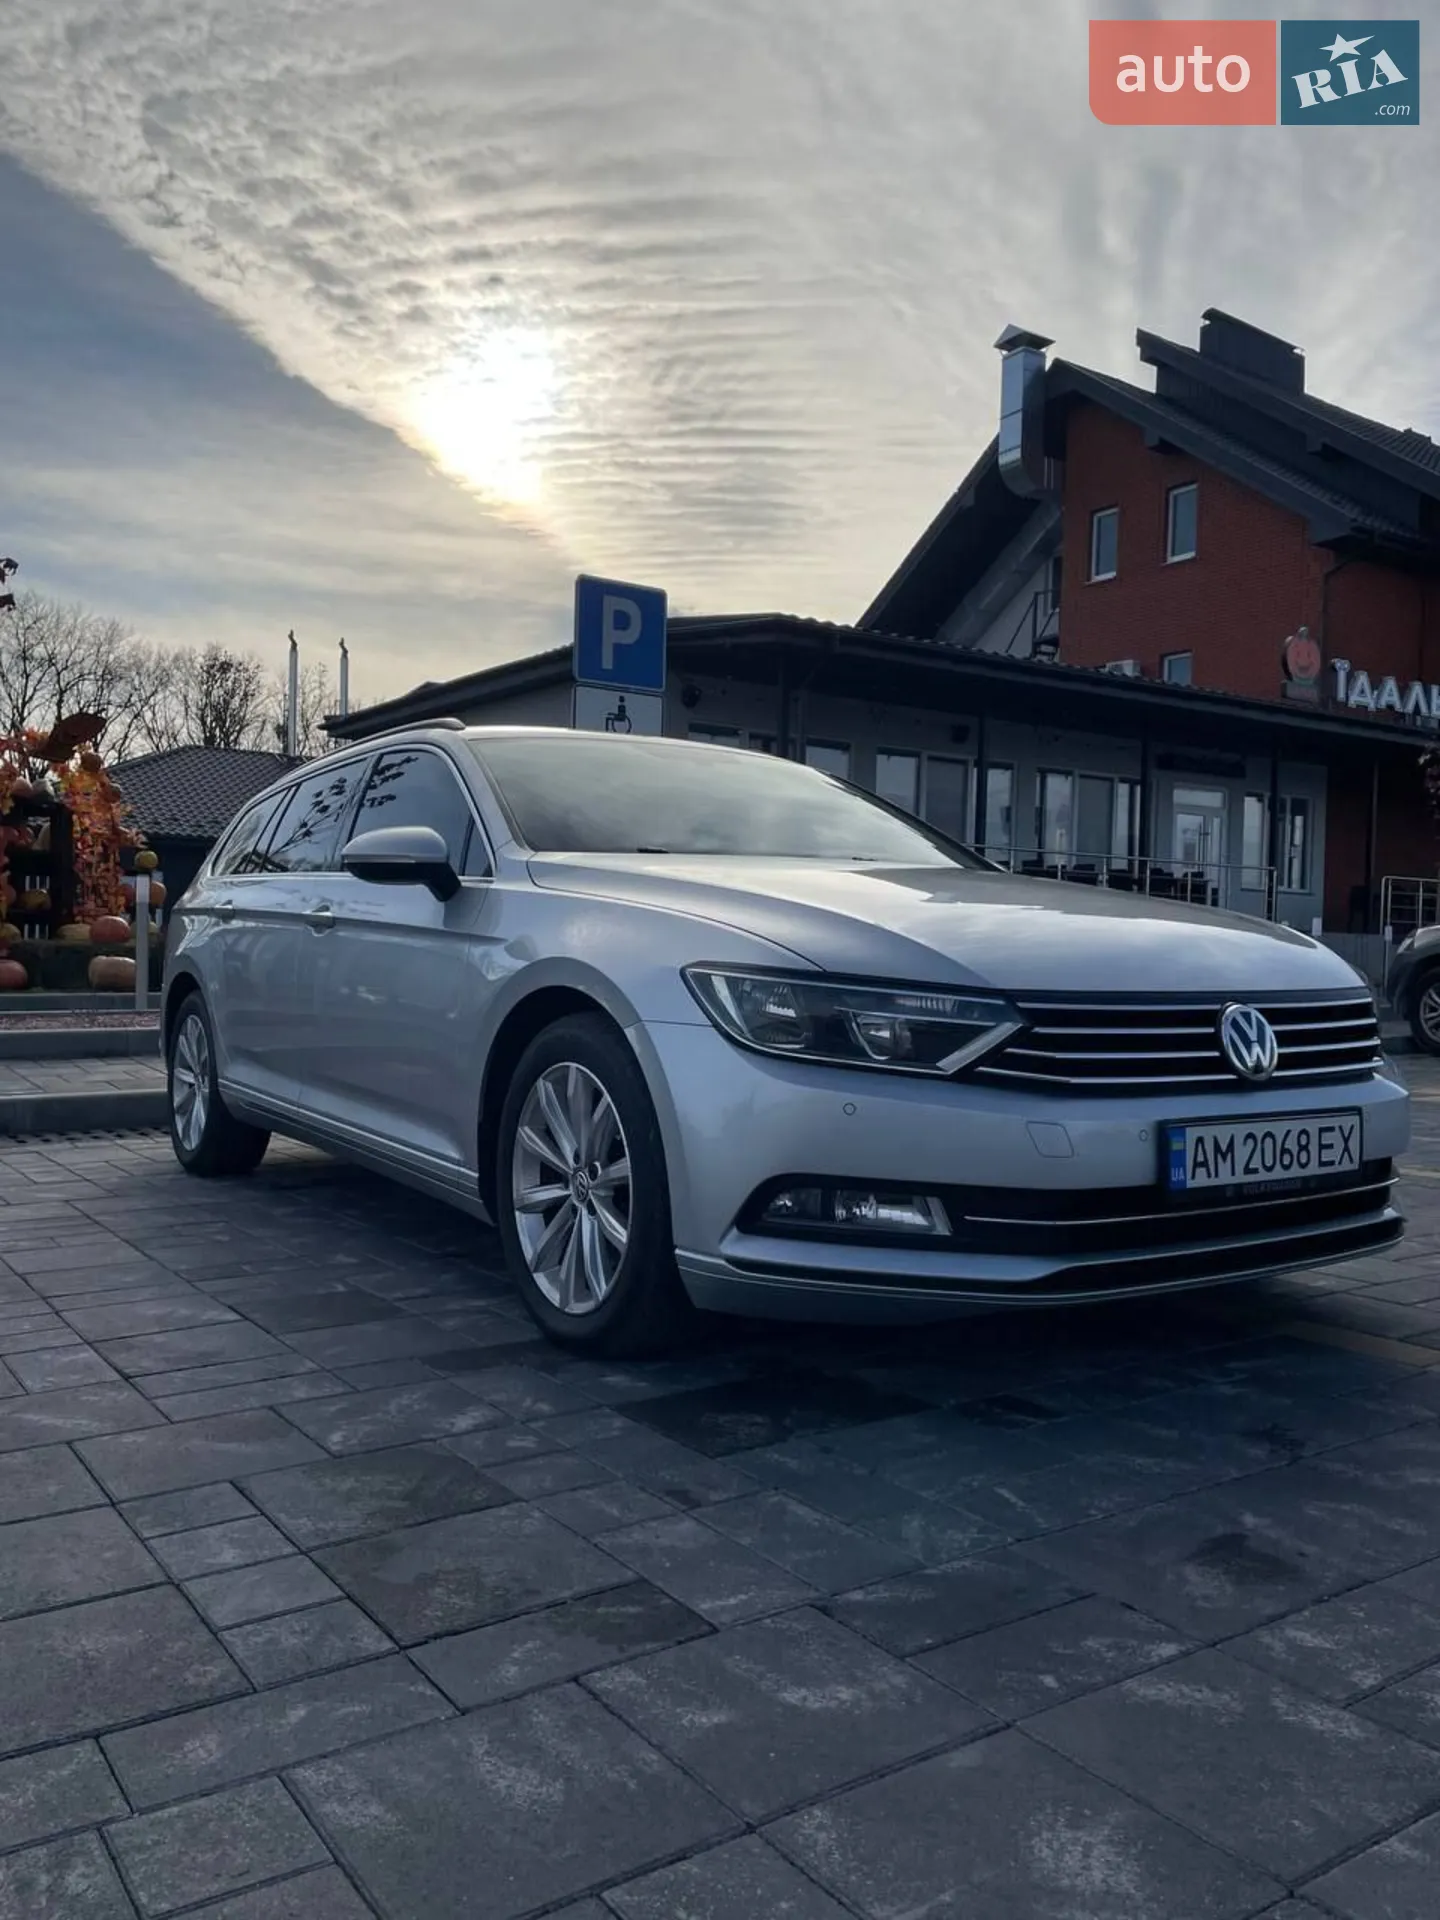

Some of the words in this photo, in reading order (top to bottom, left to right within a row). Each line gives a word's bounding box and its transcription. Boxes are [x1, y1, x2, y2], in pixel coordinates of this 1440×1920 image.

[601, 594, 643, 670] P
[1170, 1166, 1186, 1181] UA
[1190, 1133, 1236, 1181] AM
[1242, 1128, 1311, 1176] 2068
[1317, 1123, 1355, 1168] EX
